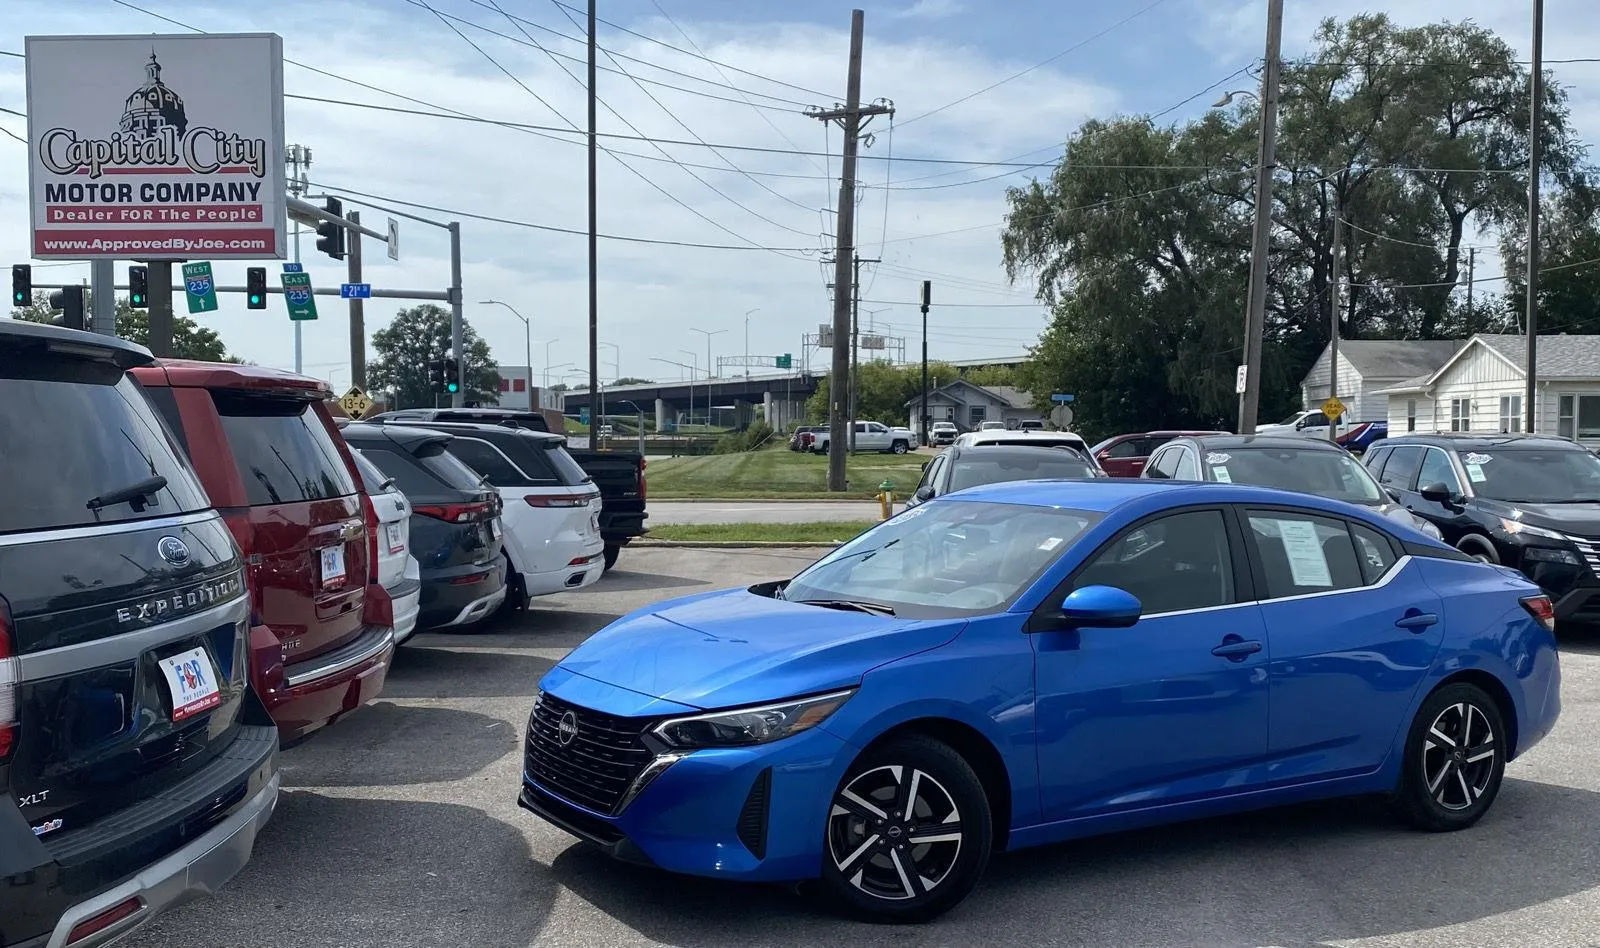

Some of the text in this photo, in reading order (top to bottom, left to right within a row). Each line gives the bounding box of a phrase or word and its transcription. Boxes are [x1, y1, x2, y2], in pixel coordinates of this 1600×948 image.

[39, 126, 266, 179] Capital City
[45, 182, 261, 203] MOTOR COMPANY
[53, 208, 257, 221] Dealer FOR The People
[43, 237, 265, 251] www.ApprovedByJoe.com
[185, 265, 208, 275] WEST
[189, 279, 210, 291] 235
[284, 275, 306, 284] EAST
[290, 289, 309, 300] 235
[116, 579, 239, 623] EXPEDITION
[19, 789, 50, 808] XLT
